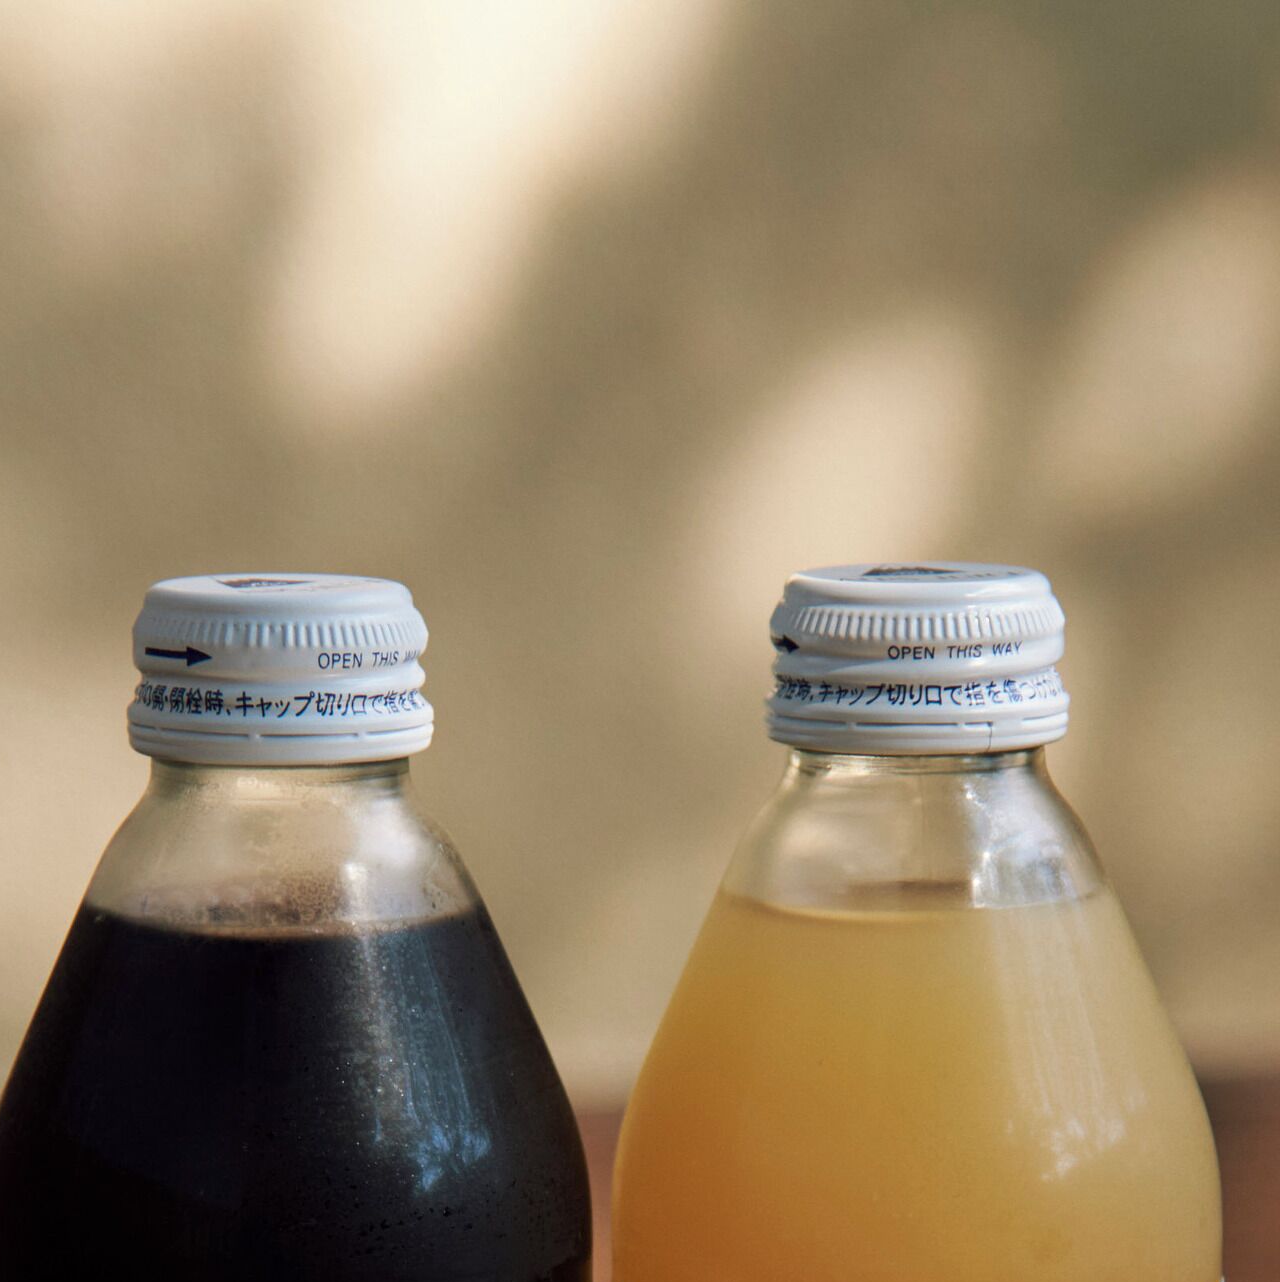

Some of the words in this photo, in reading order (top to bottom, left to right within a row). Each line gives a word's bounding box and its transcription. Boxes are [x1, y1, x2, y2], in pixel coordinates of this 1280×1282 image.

[887, 645, 935, 660] OPEN
[947, 643, 982, 658] THIS
[992, 641, 1022, 656] WAY
[318, 652, 363, 669] OPEN
[372, 651, 399, 667] THIS
